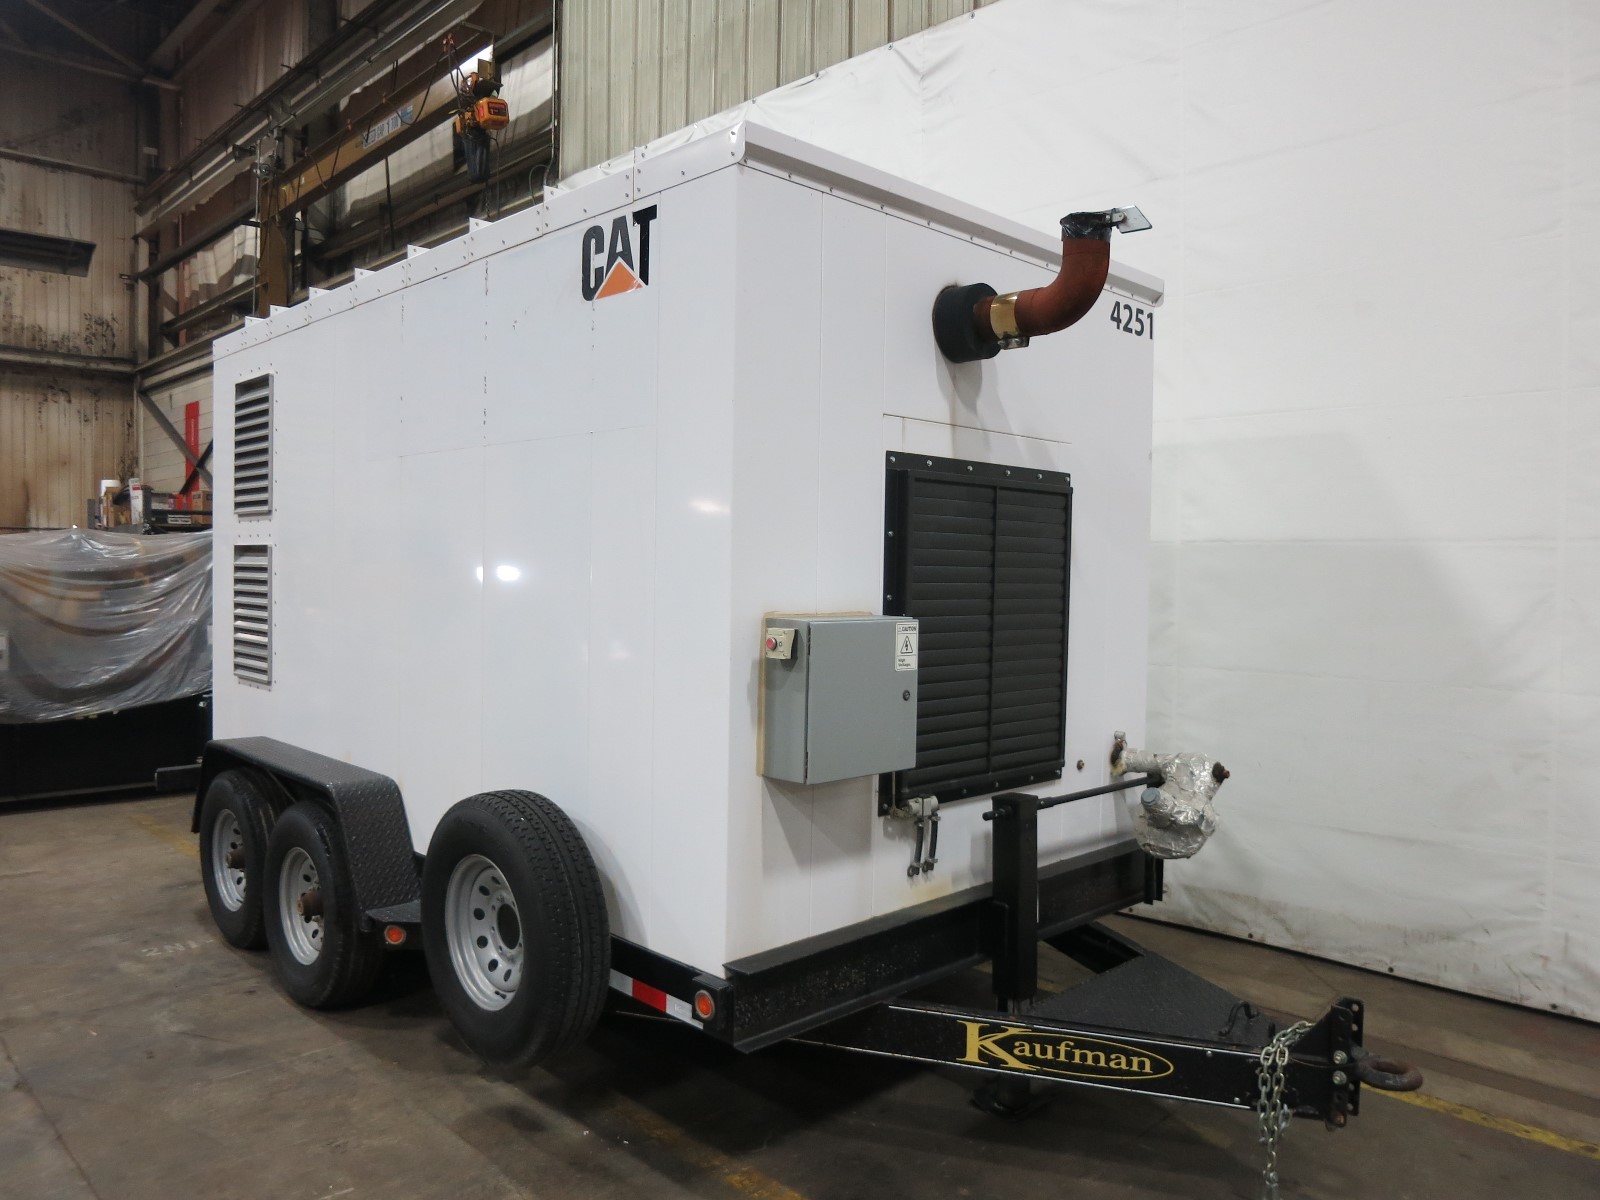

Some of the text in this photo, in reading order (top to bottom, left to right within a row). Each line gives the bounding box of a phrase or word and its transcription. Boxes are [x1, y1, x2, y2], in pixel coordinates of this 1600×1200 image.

[582, 204, 657, 301] CAT
[1110, 301, 1154, 340] 4251
[955, 1019, 1154, 1074] Kaufman
